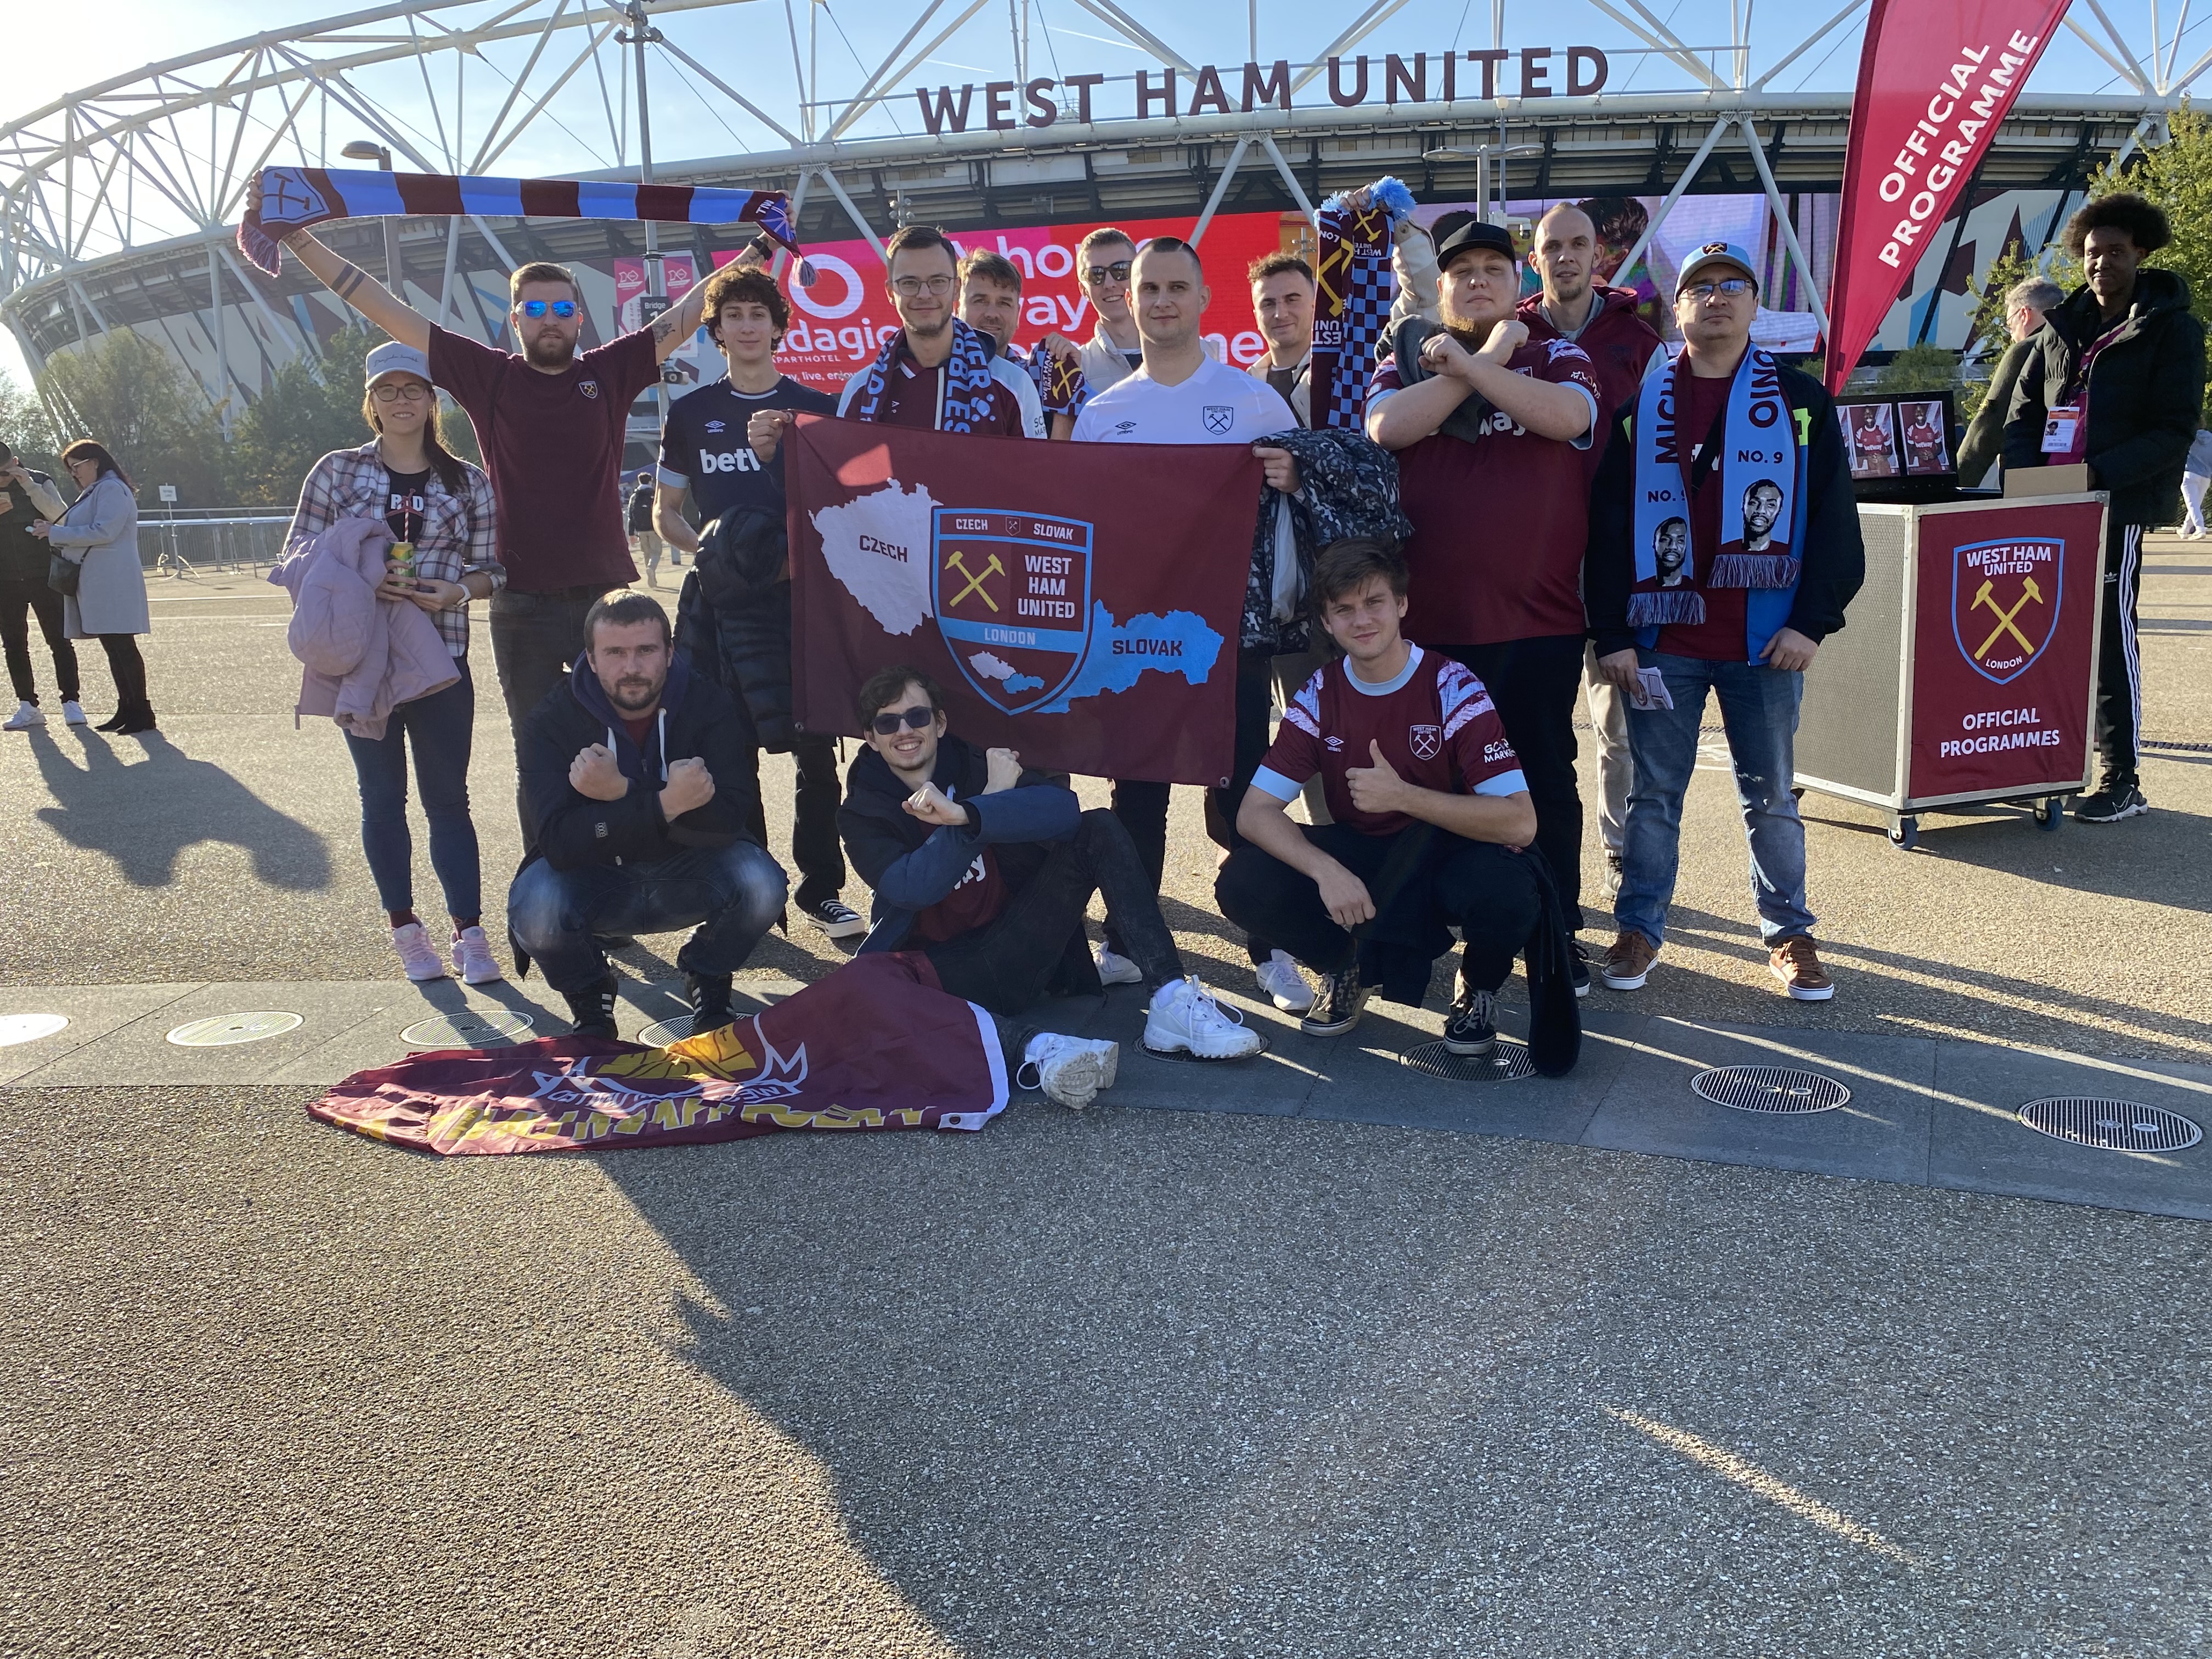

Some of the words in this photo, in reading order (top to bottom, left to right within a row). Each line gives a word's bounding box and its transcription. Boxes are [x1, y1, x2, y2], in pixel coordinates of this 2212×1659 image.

[916, 73, 1103, 134] WEST
[1136, 60, 1291, 120] HAM
[1328, 46, 1608, 107] UNITED
[1879, 44, 1990, 202] OFFICIAL
[1878, 29, 2039, 268] PROGRAMME
[1311, 331, 1341, 345] EST
[1737, 450, 1768, 464] NO.
[1773, 451, 1784, 464] 9
[1647, 490, 1676, 503] NO.
[955, 517, 988, 531] CZECH
[1033, 523, 1074, 540] SLOVAK
[859, 534, 908, 563] CZECH
[1966, 546, 2010, 567] WEST
[2013, 546, 2051, 563] HAM
[1025, 555, 1073, 575] WEST
[1983, 561, 2033, 576] UNITED
[1028, 577, 1066, 596] HAM
[1017, 598, 1075, 619] UNITED
[984, 628, 1036, 646] LONDON
[1112, 639, 1182, 657] SLOVAK
[1985, 655, 2023, 670] LONDON
[1962, 708, 2040, 730] OFFICIAL
[1940, 730, 2060, 758] PROGRAMMES
